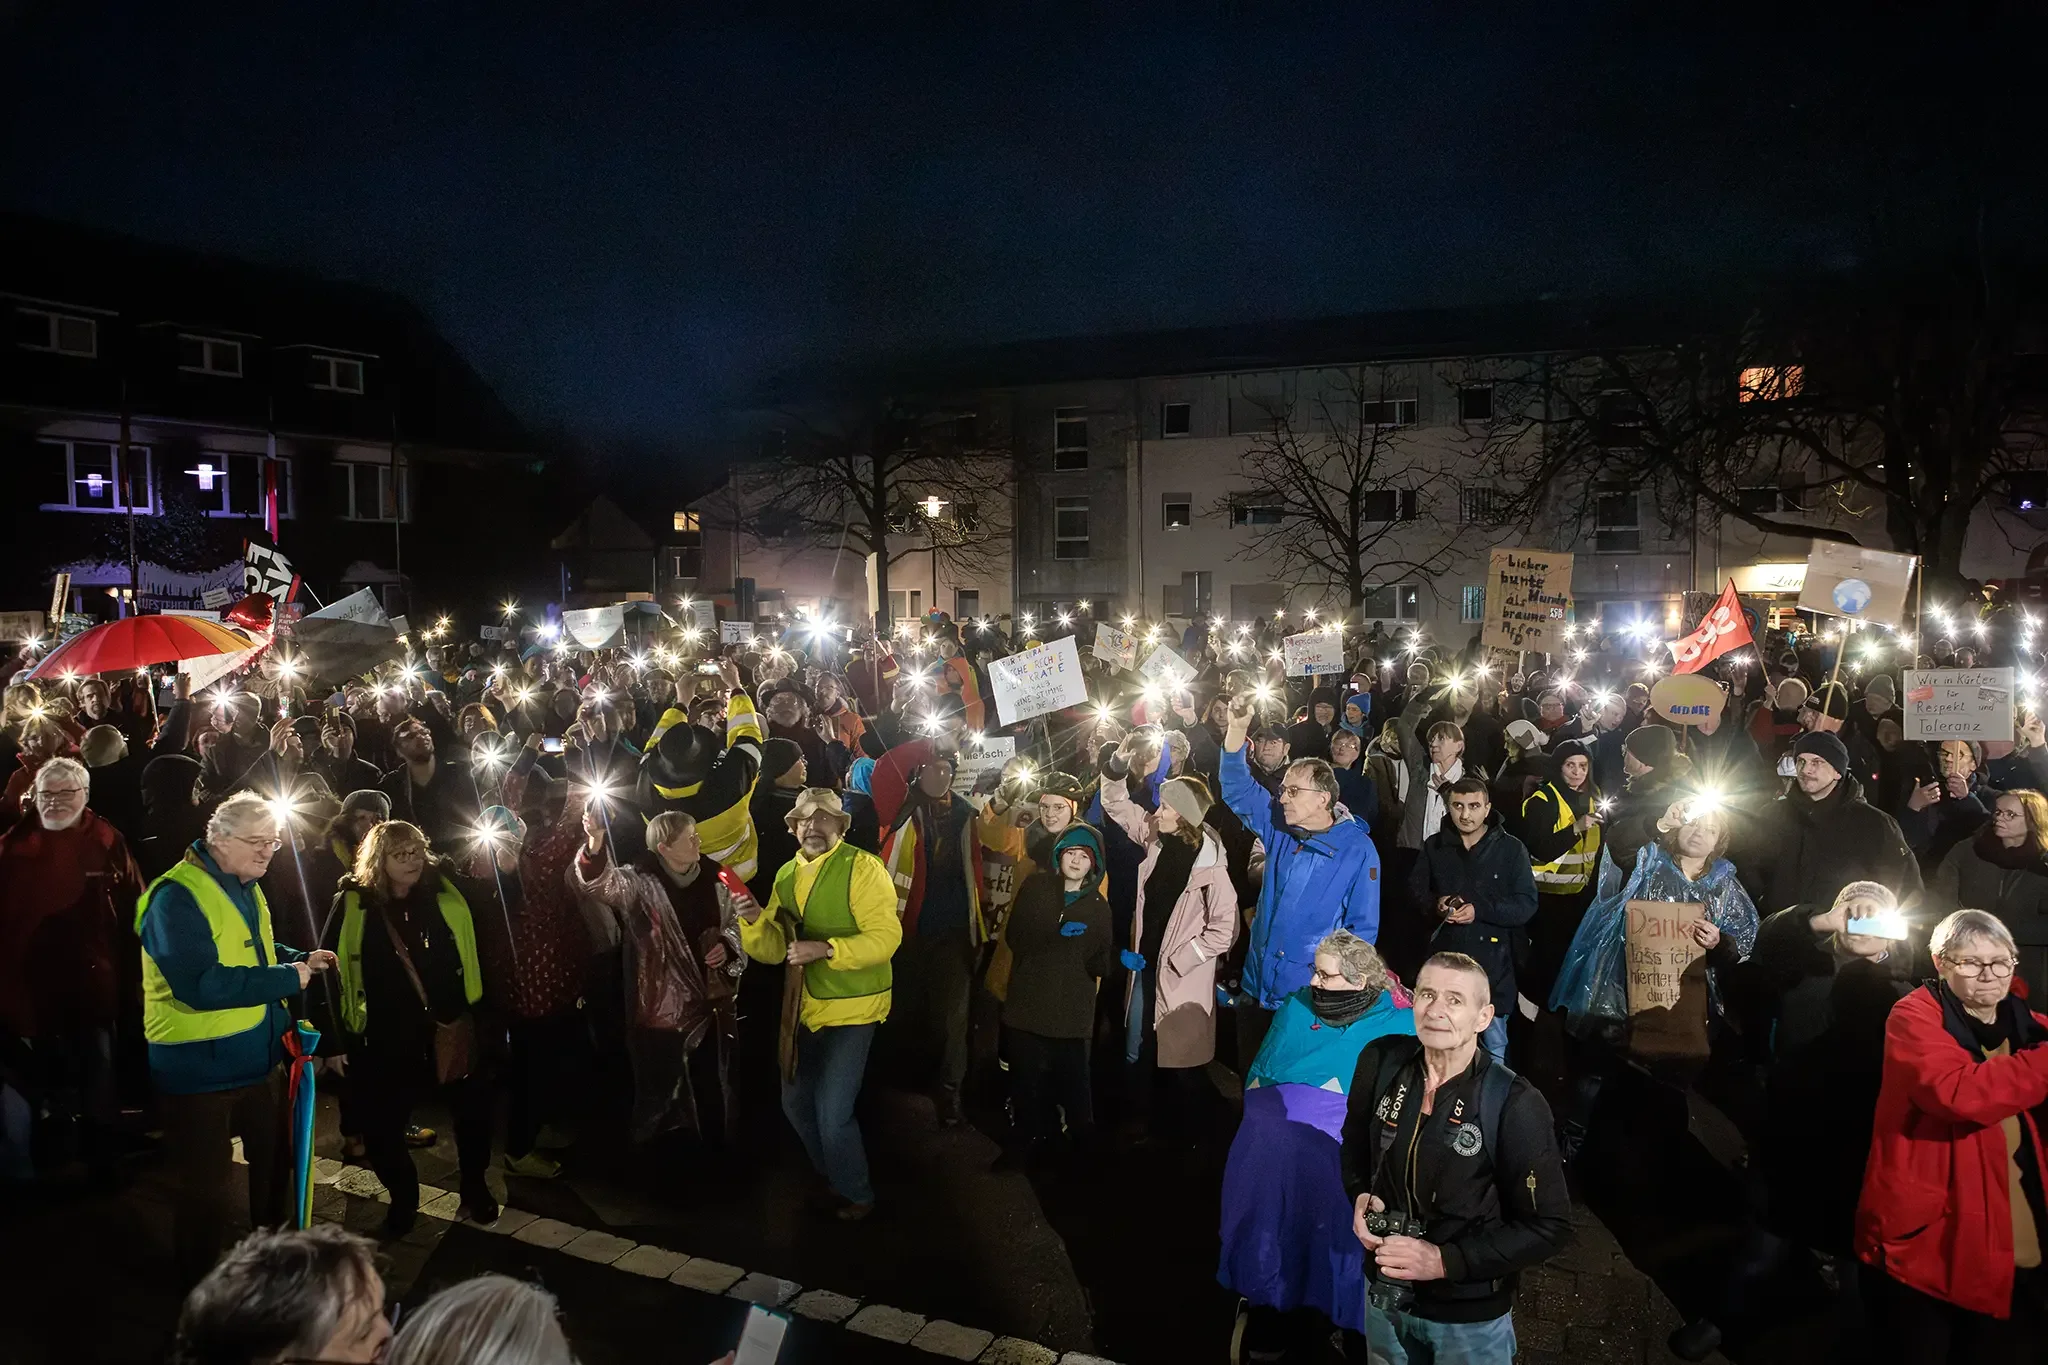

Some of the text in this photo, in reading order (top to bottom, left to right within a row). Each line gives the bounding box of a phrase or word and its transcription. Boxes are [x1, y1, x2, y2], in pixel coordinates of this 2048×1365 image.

[1508, 554, 1548, 571] Lieber
[1501, 571, 1544, 588] bunte
[1503, 606, 1546, 622] braune
[1305, 663, 1343, 674] Menschen
[1005, 663, 1064, 692] DEMKRATE
[1917, 673, 1937, 685] Wir
[1944, 676, 1953, 684] in
[1037, 685, 1063, 699] STIMME
[1917, 701, 1964, 714] Respekt
[1919, 718, 1981, 732] Toleranz
[1671, 945, 1693, 965] ich
[1630, 966, 1671, 988] hierher
[1391, 1084, 1407, 1119] SONY
